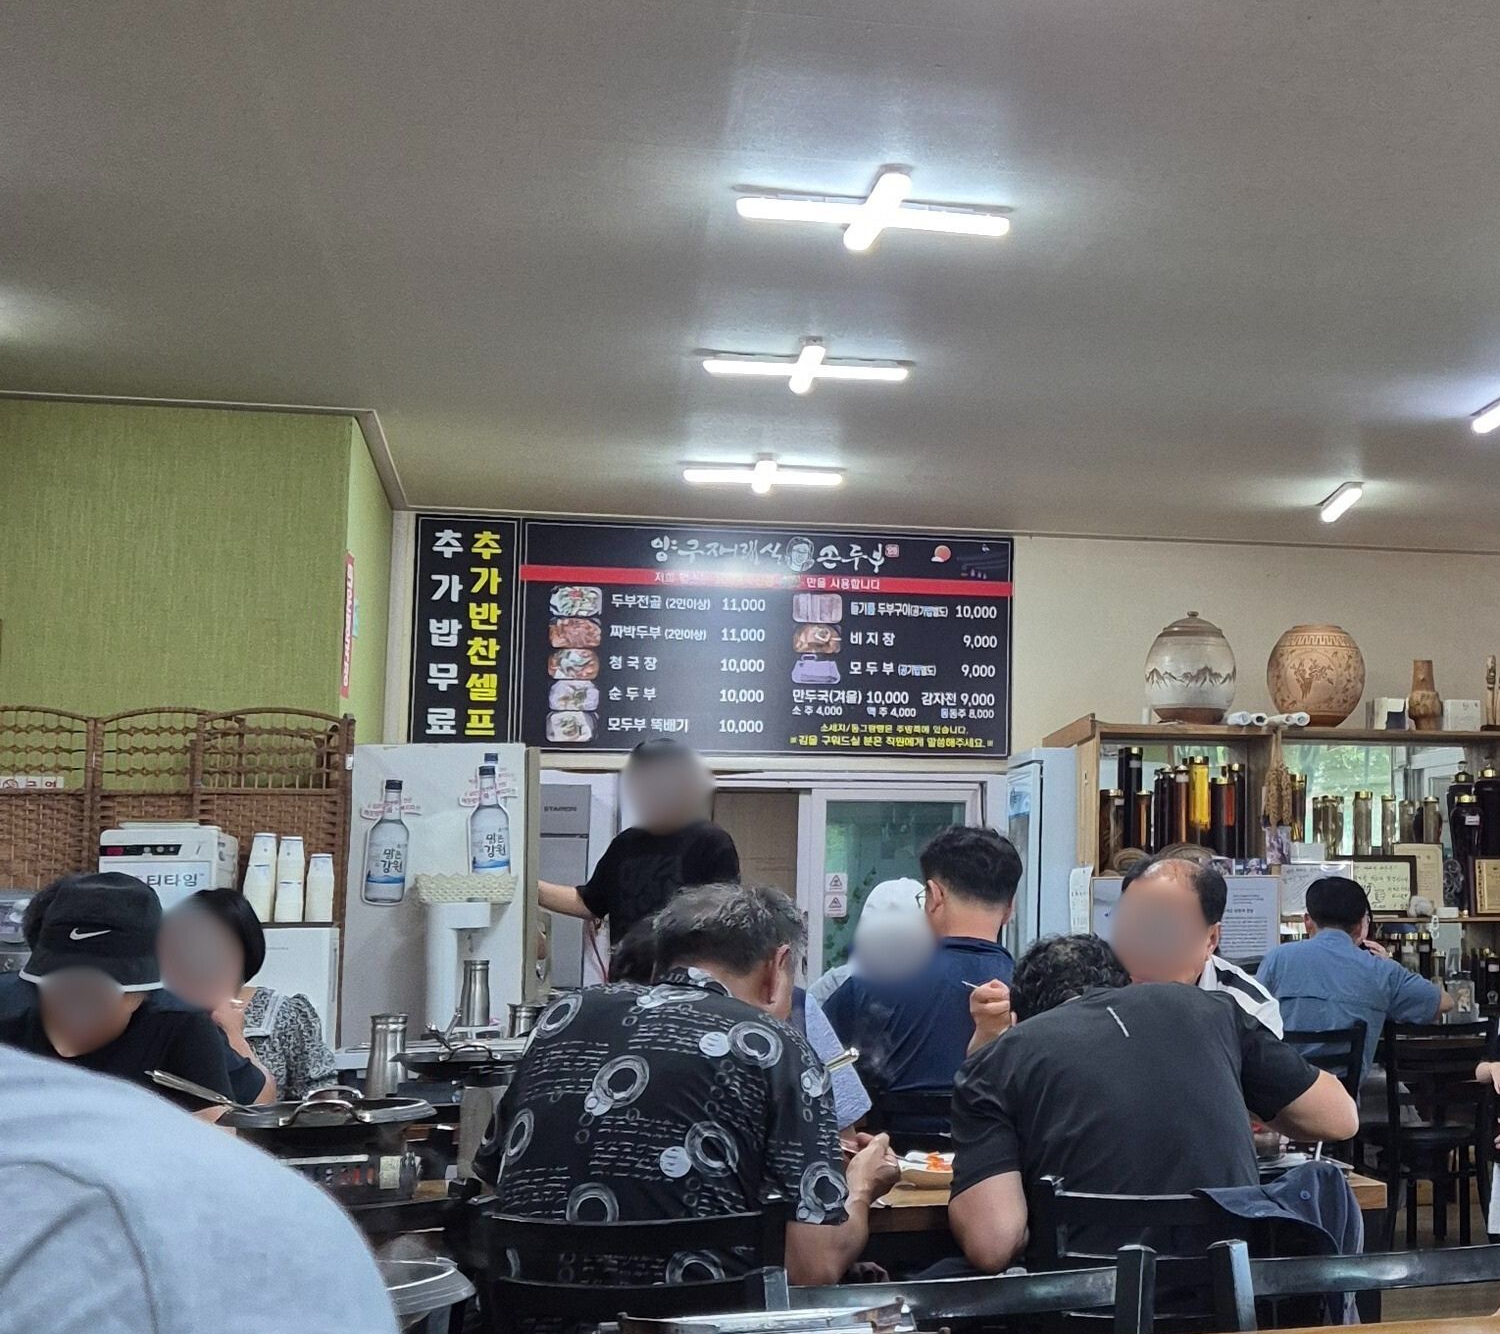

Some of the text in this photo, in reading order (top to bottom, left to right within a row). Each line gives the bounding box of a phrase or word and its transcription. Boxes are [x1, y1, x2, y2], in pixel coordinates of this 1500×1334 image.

[830, 578, 881, 590] 사용합니다
[611, 594, 766, 612] 두부전골 (2인이상) 11,000
[955, 605, 998, 619] 10,000
[609, 625, 766, 642] 짜박두부 (2인이상) 11,000
[963, 635, 998, 649] 9,000
[720, 659, 765, 673] 10,000
[961, 665, 996, 678] 9,000
[719, 689, 765, 703] 10,000
[866, 691, 909, 705] 10,000
[960, 693, 995, 707] 9,000
[816, 706, 843, 717] 4,000
[890, 708, 917, 718] 4,000
[968, 709, 995, 719] 8,000
[607, 717, 764, 734] 모두부 뚝배기 10,000
[380, 860, 403, 874] 강원
[146, 873, 199, 887] 티타임
